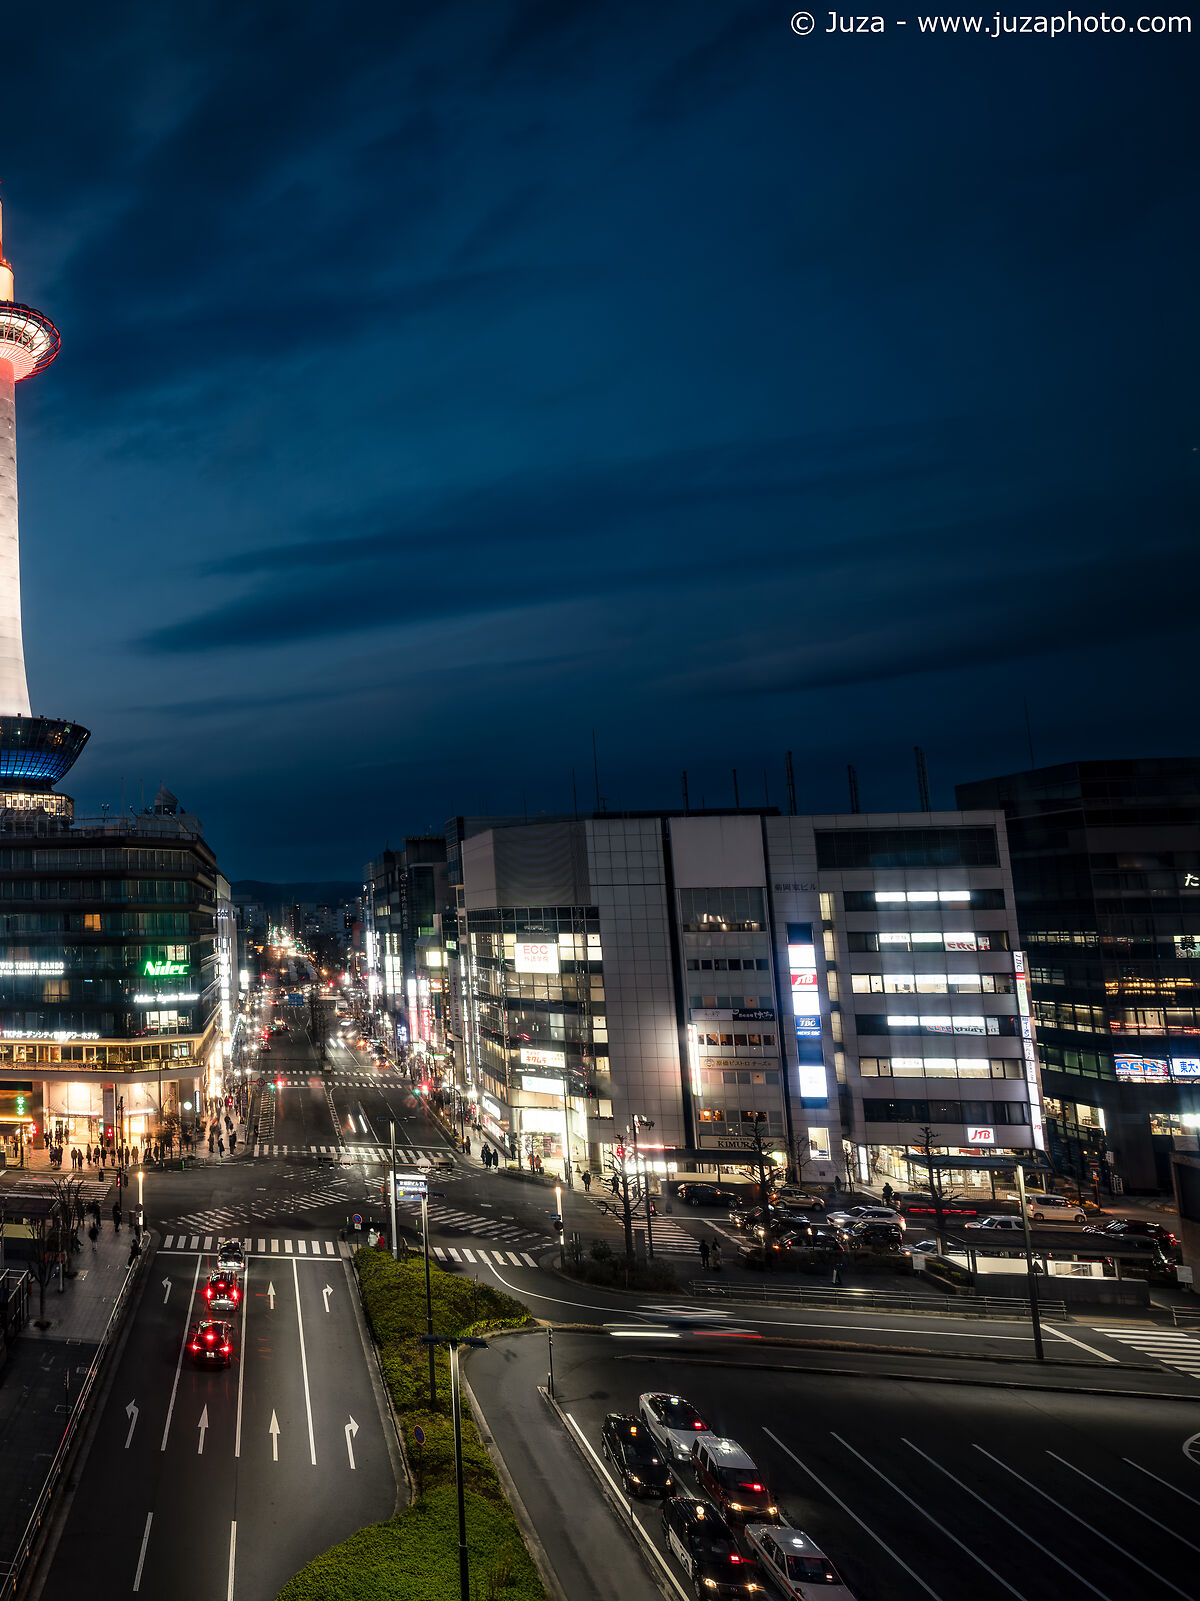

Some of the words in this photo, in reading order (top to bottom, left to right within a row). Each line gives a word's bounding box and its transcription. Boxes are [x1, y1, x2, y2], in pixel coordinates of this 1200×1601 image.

[523, 944, 549, 955] ECC
[14, 961, 39, 970] TOWER
[40, 961, 65, 970] SANDO
[143, 960, 190, 976] Nidec
[794, 974, 814, 985] JTB
[2, 1030, 100, 1040] TKPガーデンシティタワーホテル
[971, 1129, 991, 1141] JTB
